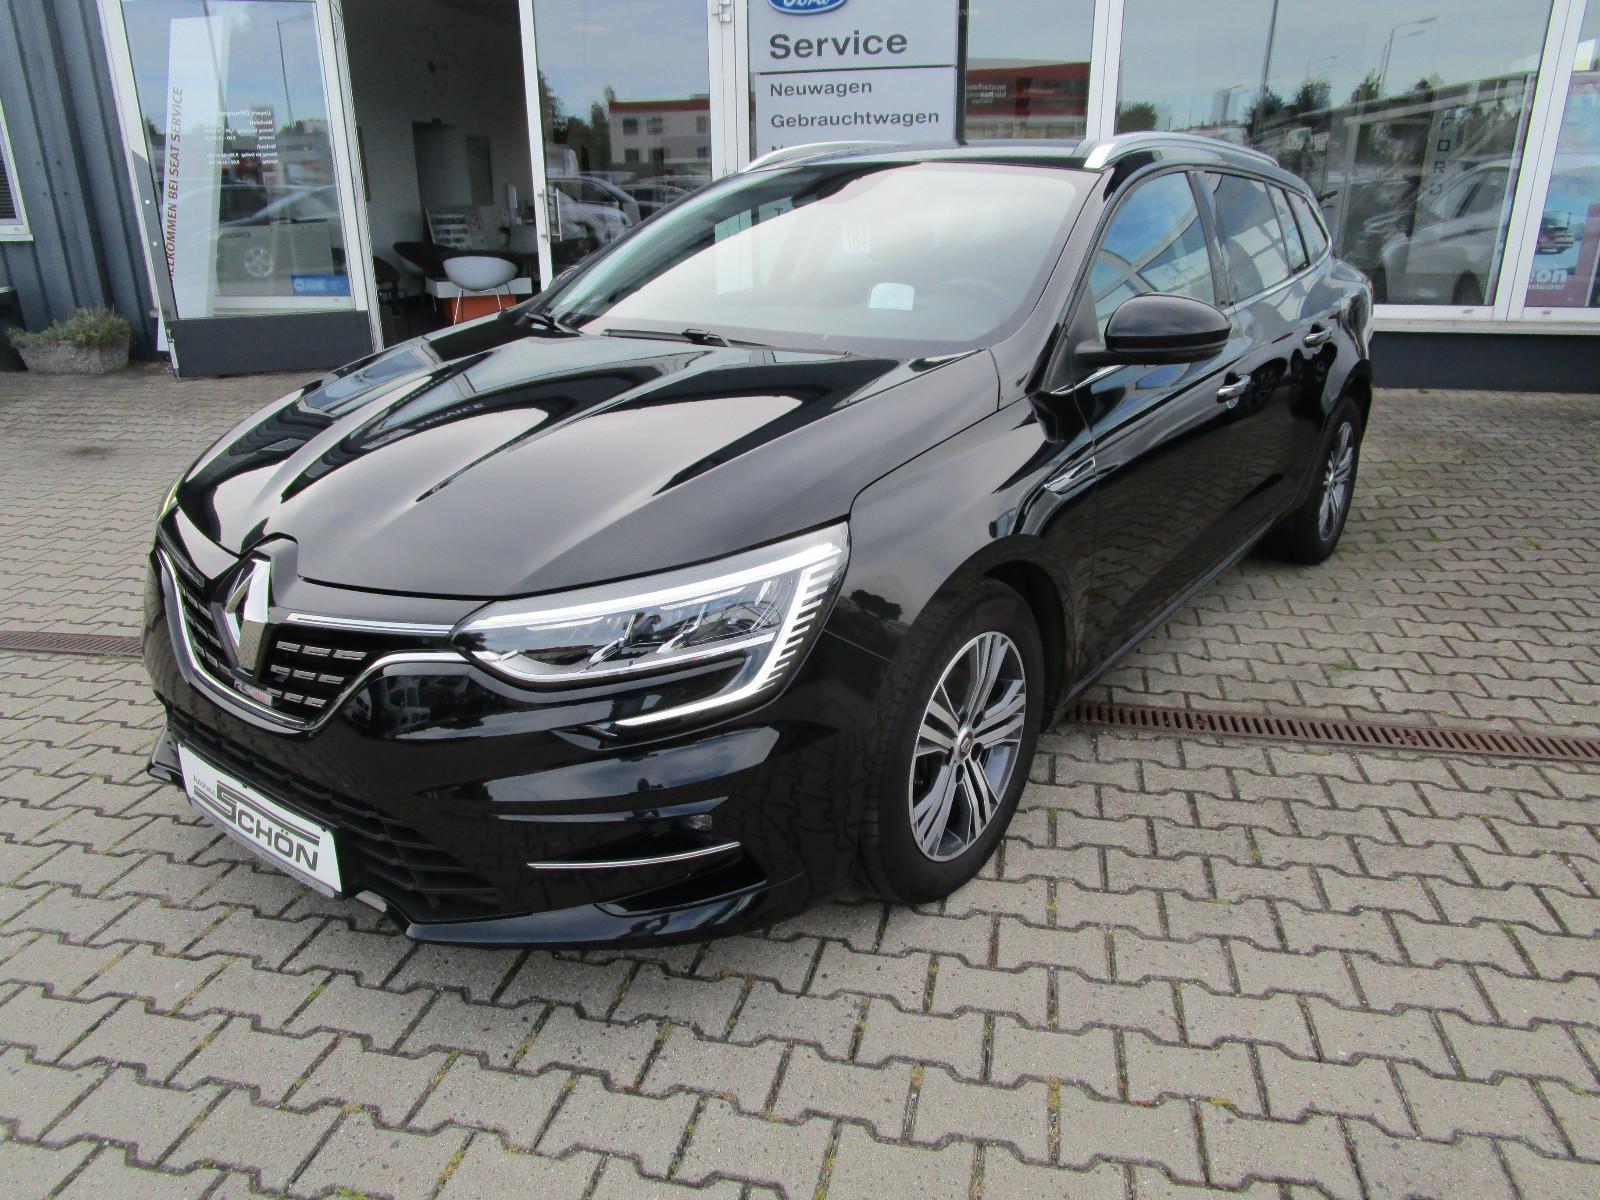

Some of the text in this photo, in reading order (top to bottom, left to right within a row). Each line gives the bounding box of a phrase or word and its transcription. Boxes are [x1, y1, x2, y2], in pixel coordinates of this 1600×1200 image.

[769, 30, 908, 60] Service
[770, 80, 873, 97] Neuwagen
[170, 87, 183, 143] SERVICE
[770, 110, 940, 129] Gebrauchtwagen
[169, 144, 180, 177] SEAT
[168, 179, 179, 200] BEI
[193, 779, 320, 872] SCHÖN
